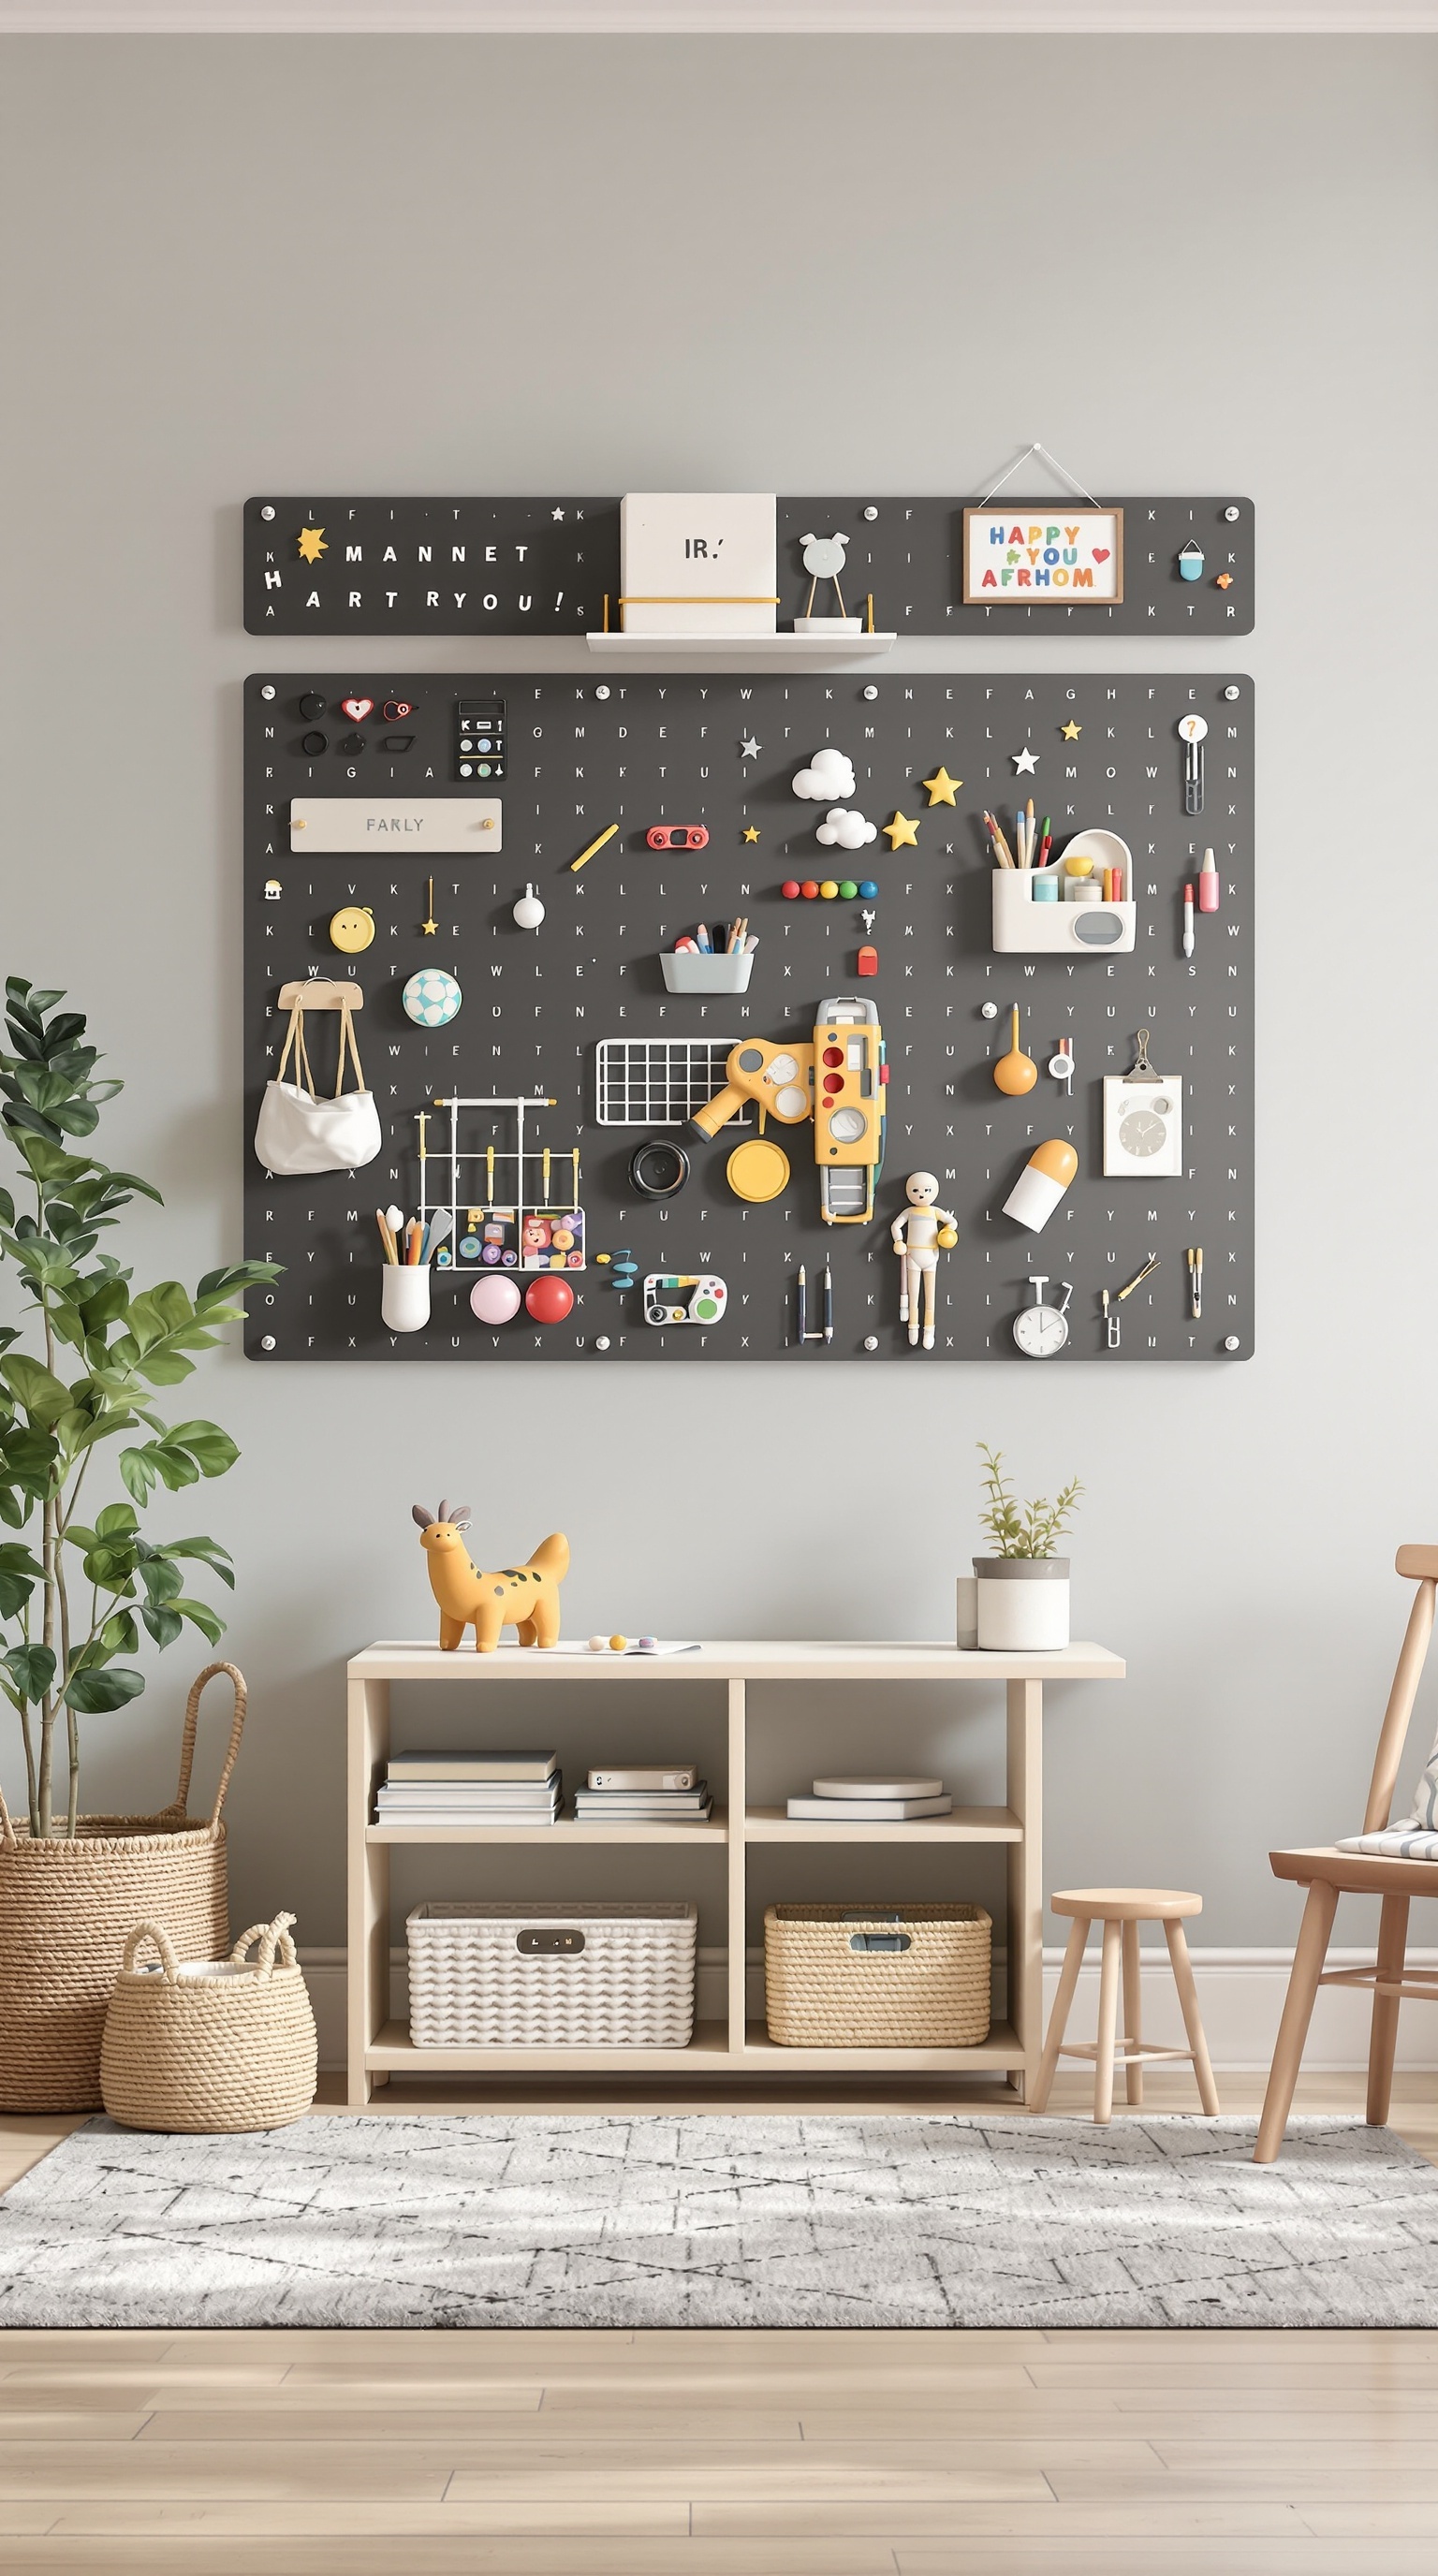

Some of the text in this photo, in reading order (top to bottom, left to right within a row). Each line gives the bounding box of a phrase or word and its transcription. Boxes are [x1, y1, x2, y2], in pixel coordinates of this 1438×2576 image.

[308, 509, 913, 521] L F T K F
[990, 526, 1080, 545] HAPPY
[1027, 548, 1078, 565] YOU
[1227, 552, 1236, 564] K
[265, 605, 275, 617] A
[985, 606, 992, 617] T
[1148, 605, 1156, 617] K
[1186, 606, 1196, 617] T
[1226, 606, 1236, 618] R
[576, 688, 1196, 700] K T Y Y W K E F A G H E
[265, 719, 1154, 739] N K M D E F K L K L
[346, 766, 1237, 779] G A F K T U F M O W N
[265, 804, 274, 815] R
[1066, 804, 1075, 815] K
[1108, 804, 1115, 815] L
[265, 842, 1236, 854] A K E Y
[347, 884, 357, 895] V
[389, 884, 398, 895] K
[620, 884, 626, 896] L
[660, 884, 667, 896] L
[700, 884, 708, 895] Y
[905, 884, 913, 895] F
[1228, 884, 1236, 896] K
[266, 925, 1240, 936] K K E F F W
[267, 965, 1237, 977] L U W L E F X K W Y E S N
[535, 1005, 542, 1017] F
[576, 1005, 585, 1017] N
[619, 1005, 627, 1017] E
[700, 1005, 708, 1017] F
[905, 1006, 913, 1017] E
[946, 1006, 954, 1017] F
[1066, 1005, 1075, 1017] Y
[1107, 1005, 1116, 1017] U
[1148, 1005, 1156, 1017] U
[1188, 1005, 1196, 1017] Y
[1228, 1005, 1237, 1017] U
[389, 1045, 1236, 1057] W E N T F U K
[389, 1084, 1236, 1096] X V N X
[904, 1124, 1075, 1136] Y X T F Y
[389, 1168, 1237, 1180] N M F N
[346, 1210, 358, 1222] M
[700, 1210, 708, 1222] F
[1067, 1210, 1075, 1221] F
[1107, 1210, 1115, 1222] Y
[1228, 1210, 1236, 1222] K
[306, 1251, 1236, 1263] Y L W L Y U X
[265, 1294, 1237, 1306] O K L N
[308, 1336, 954, 1348] F X Y U X U F X X
